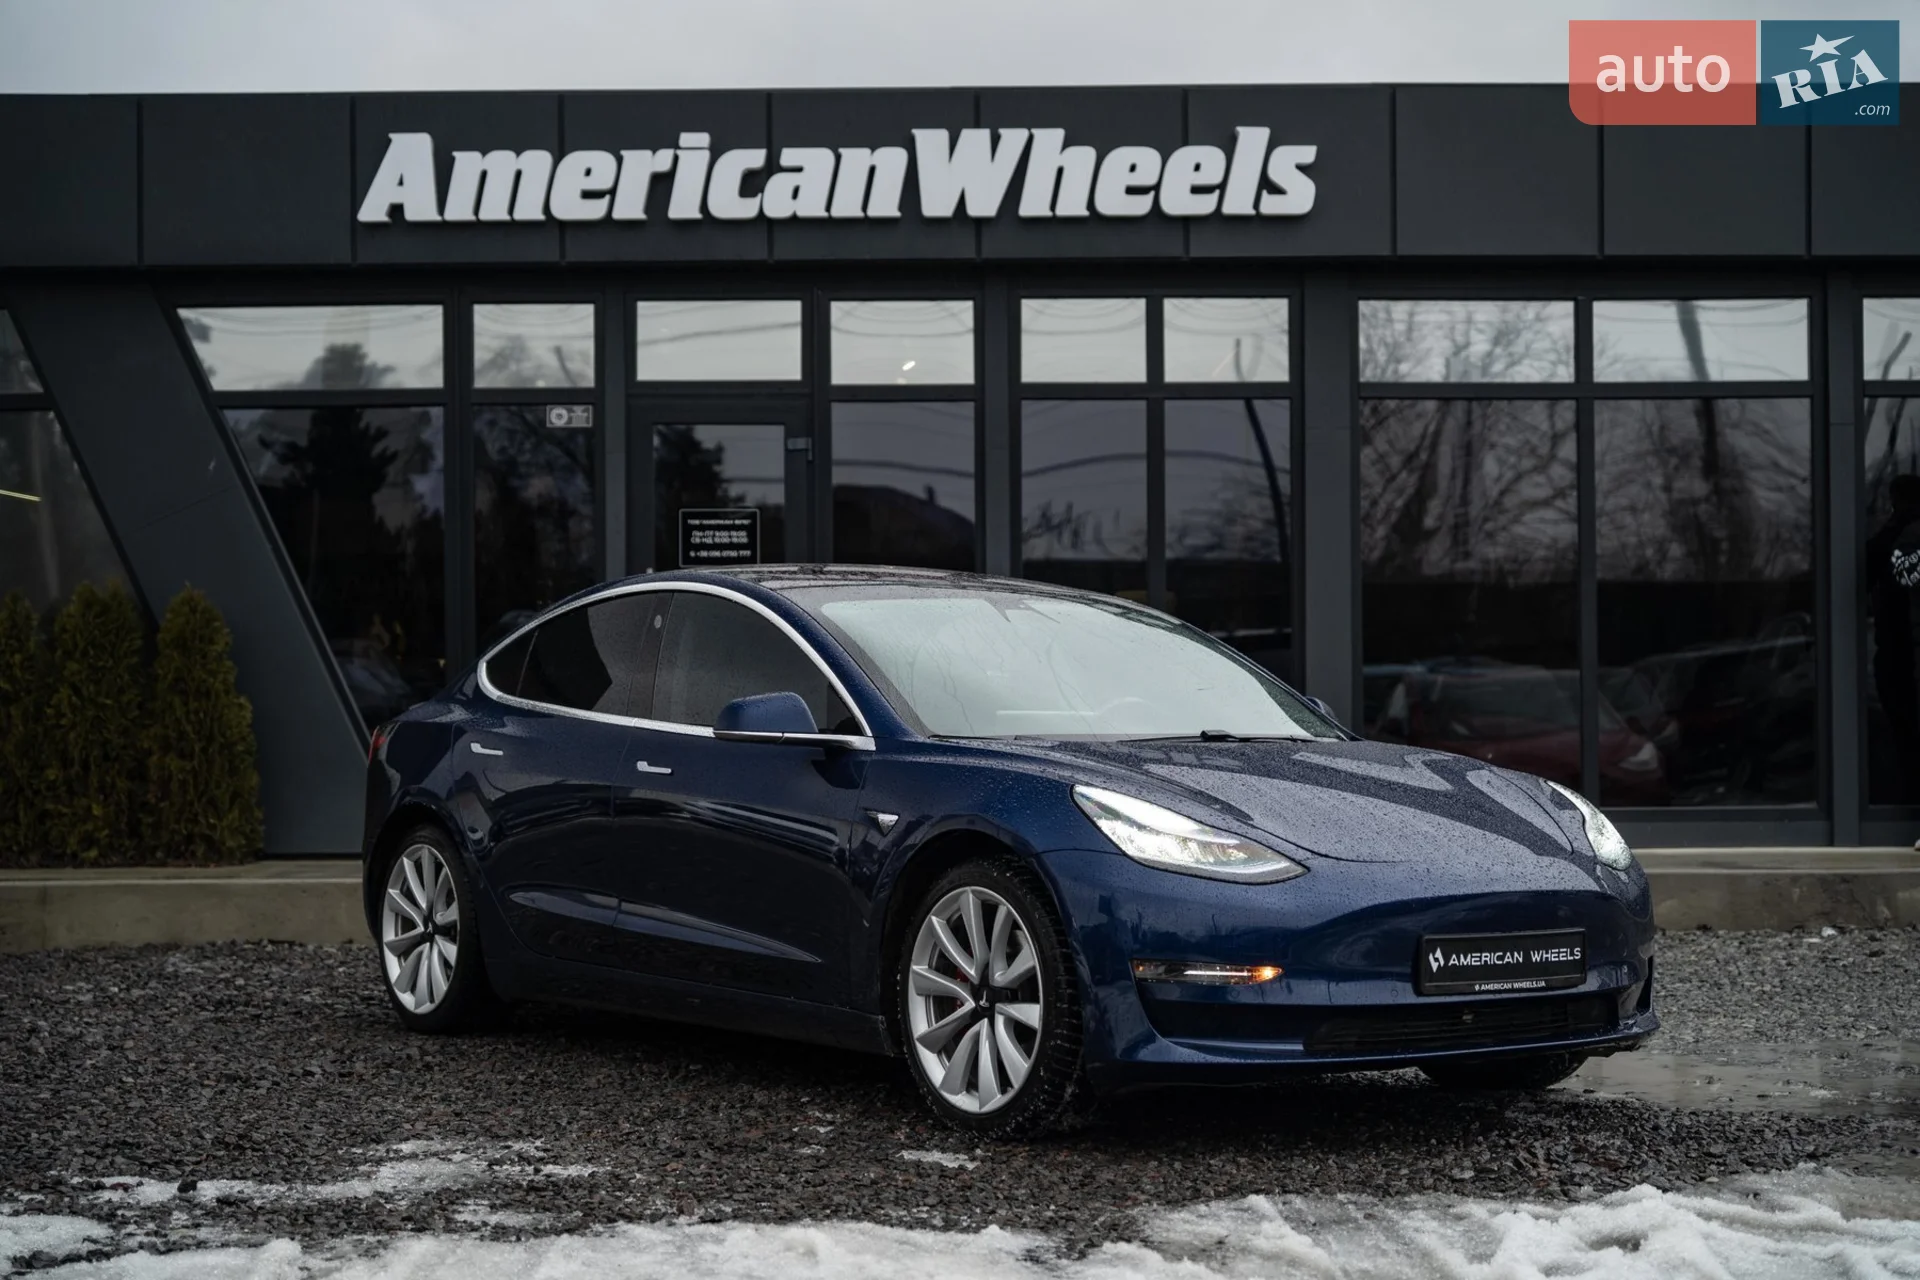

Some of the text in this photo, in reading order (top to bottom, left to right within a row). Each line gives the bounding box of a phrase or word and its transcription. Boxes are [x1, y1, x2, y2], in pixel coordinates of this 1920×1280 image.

[357, 125, 1318, 223] AmericanWheels
[1448, 948, 1581, 966] AMERICAN WHEELS
[1481, 981, 1546, 991] AMERICAN WHEELS.UA
